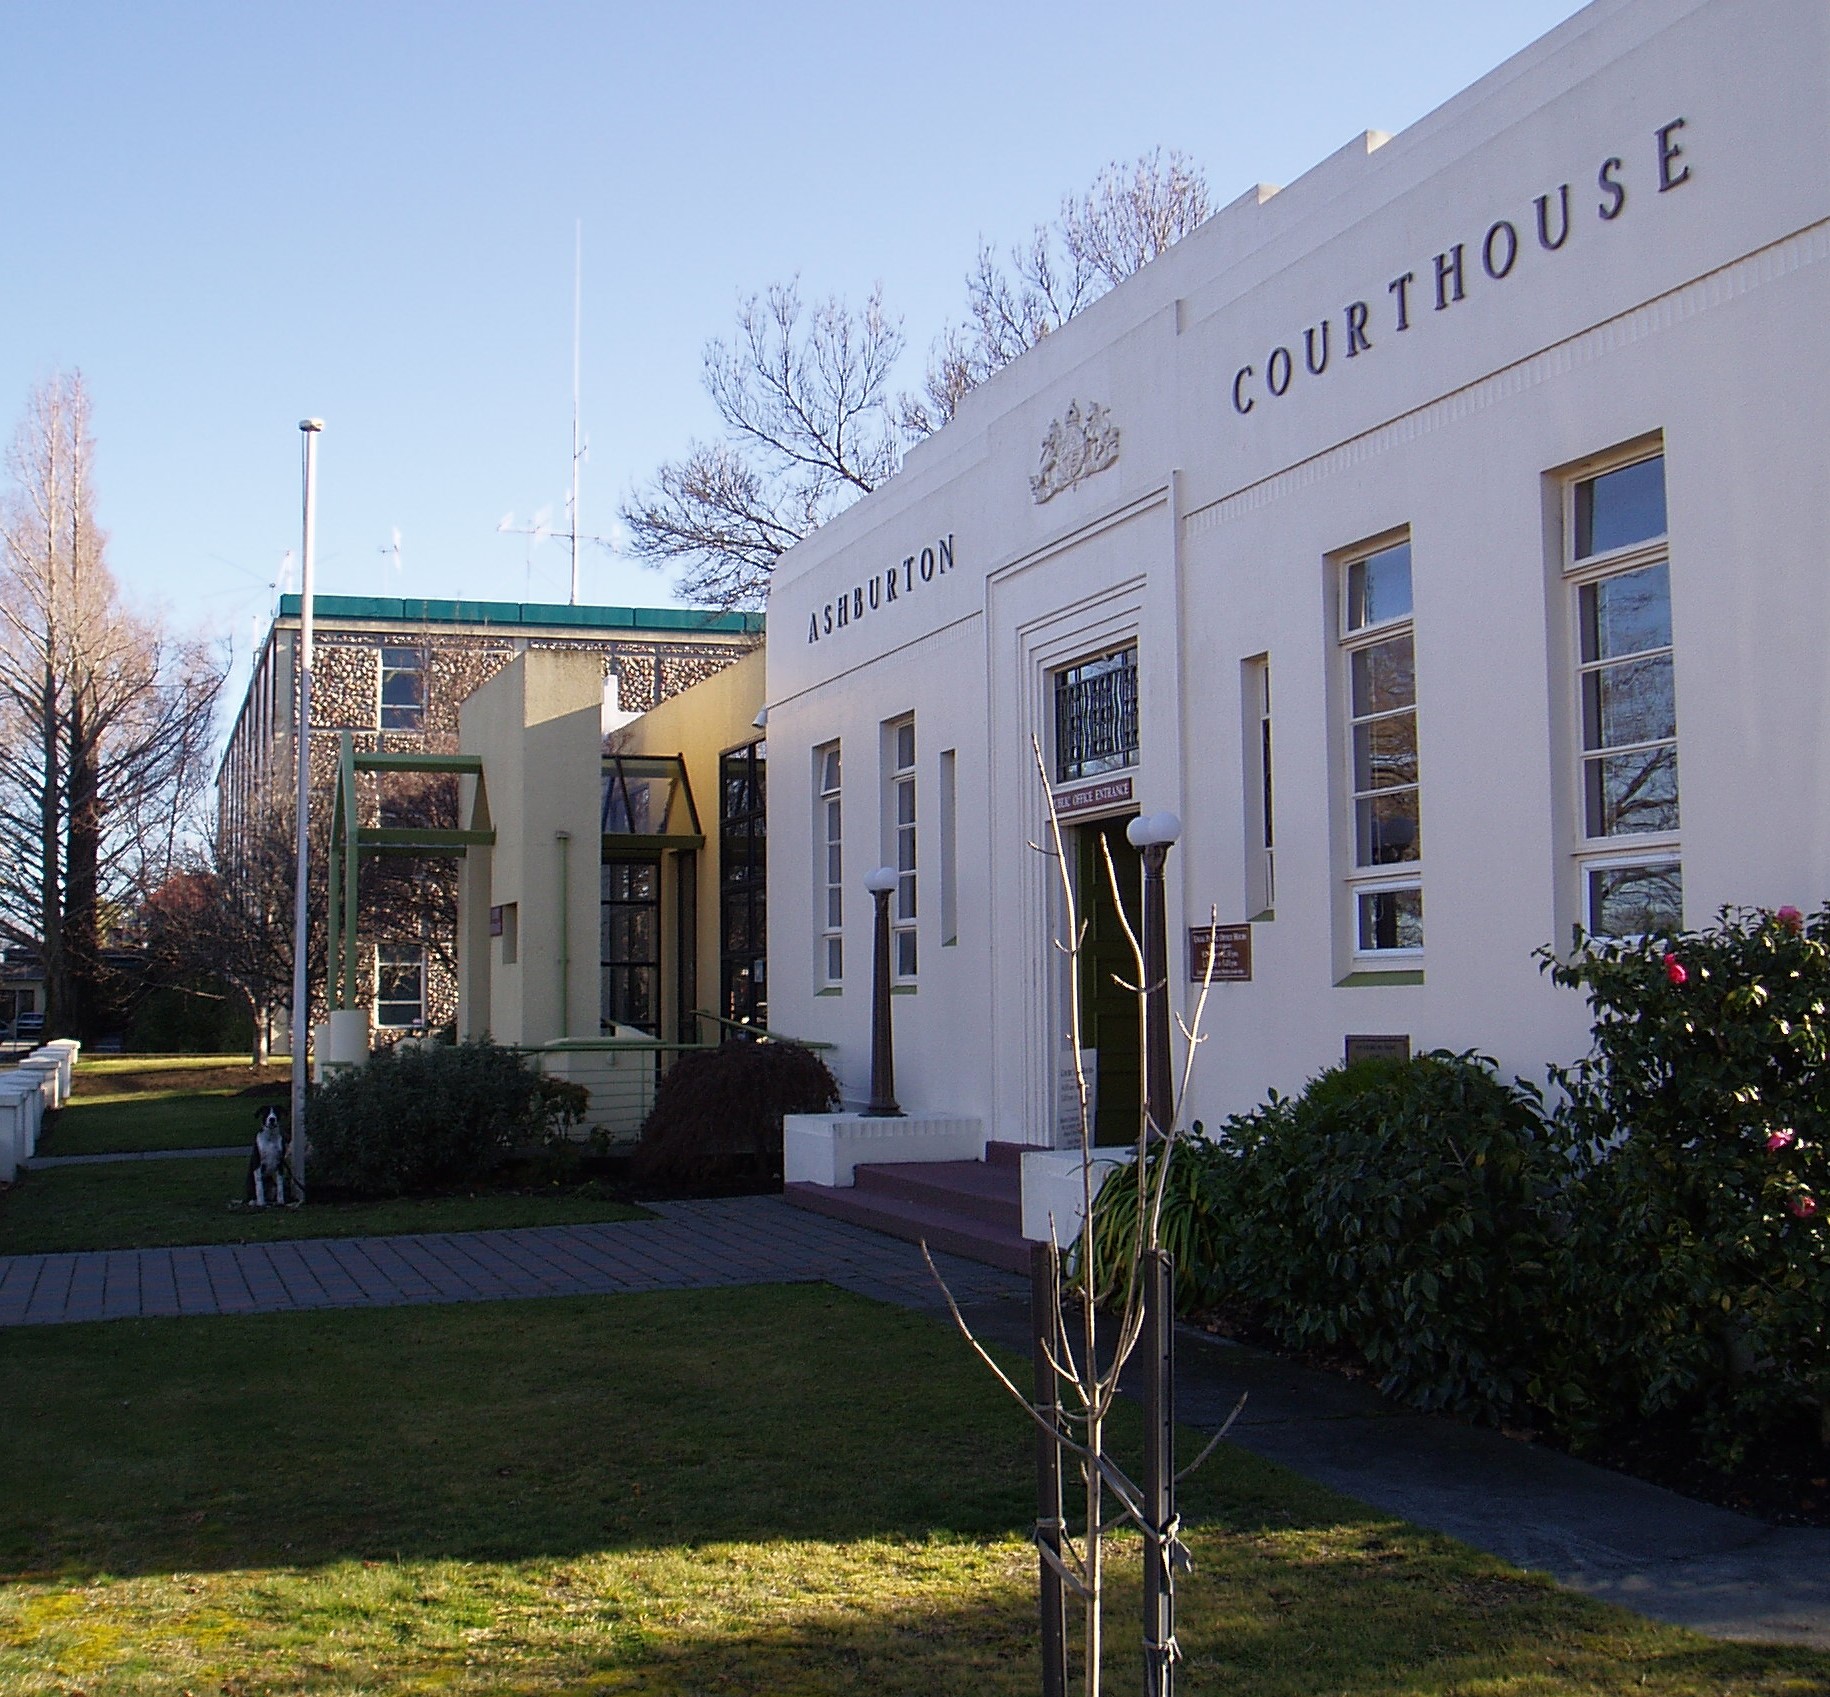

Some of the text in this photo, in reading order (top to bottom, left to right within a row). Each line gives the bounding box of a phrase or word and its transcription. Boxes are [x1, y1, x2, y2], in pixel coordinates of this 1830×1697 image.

[808, 117, 1690, 644] ASHBURTON COURTHOUSE
[1072, 791, 1094, 806] OFFICE
[1095, 783, 1130, 801] ENTRANCE
